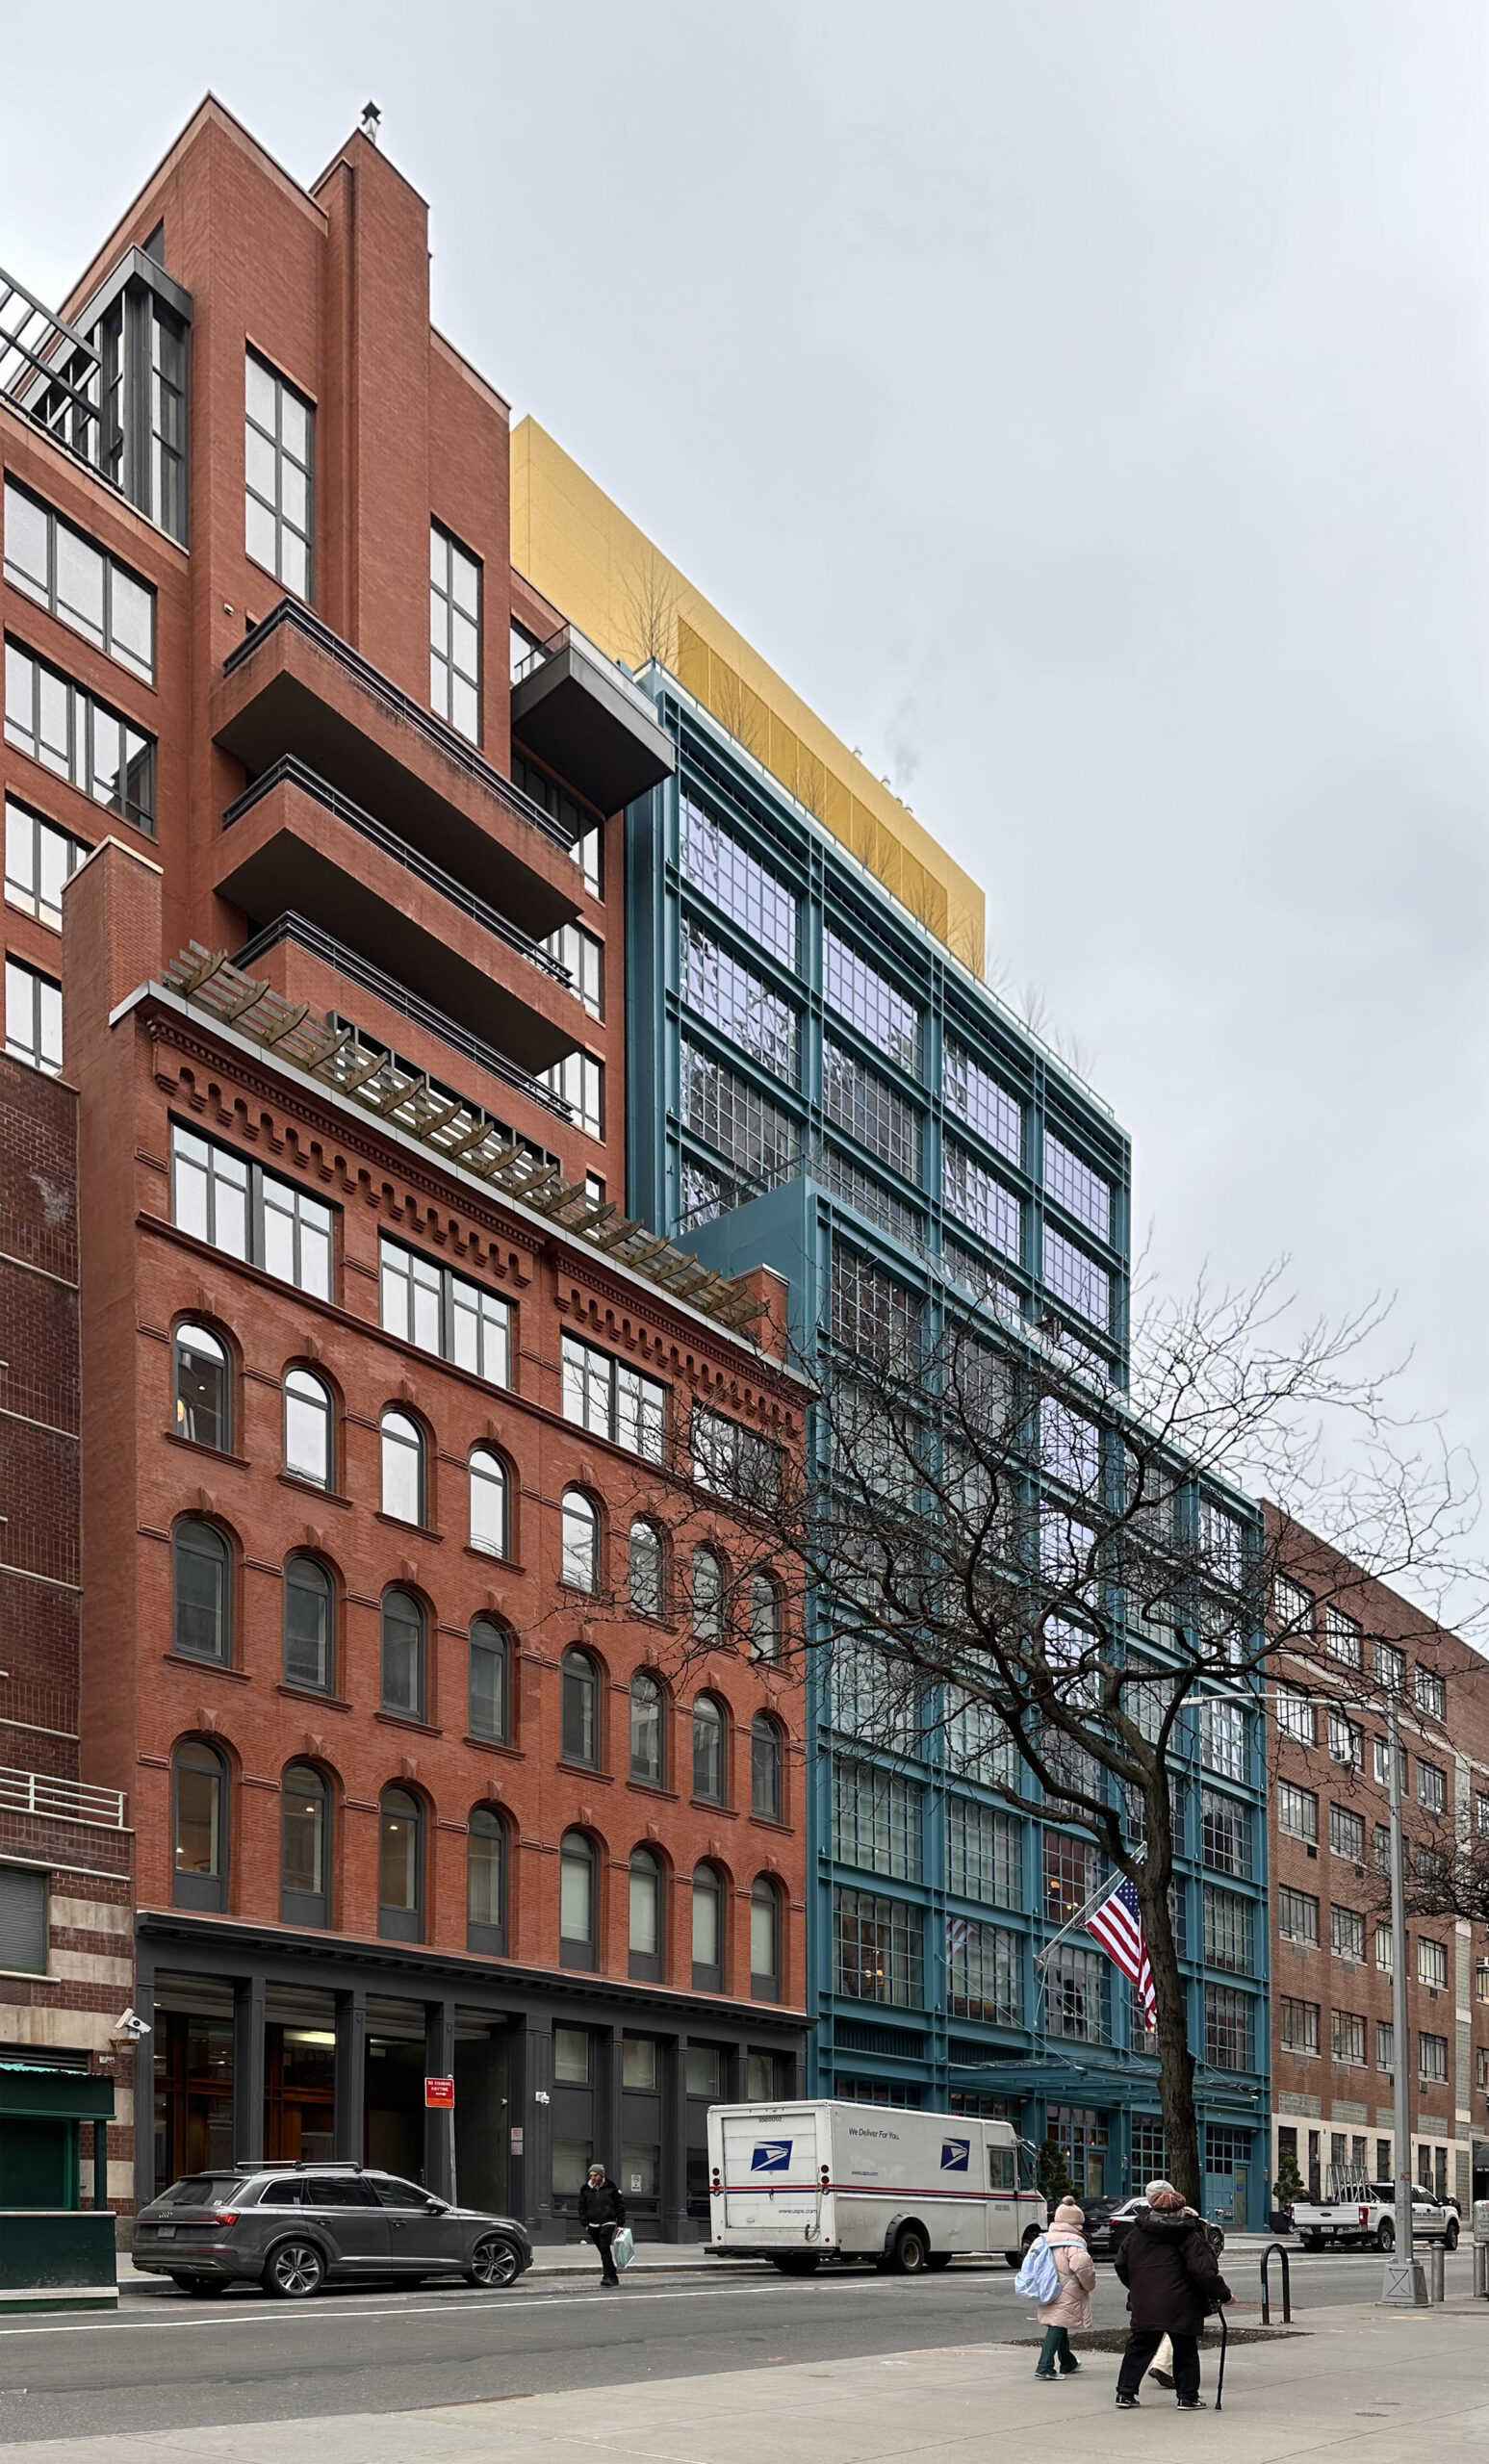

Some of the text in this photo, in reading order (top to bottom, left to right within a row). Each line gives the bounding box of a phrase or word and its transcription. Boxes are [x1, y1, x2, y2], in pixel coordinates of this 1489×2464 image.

[849, 2127, 858, 2136] We
[859, 2128, 878, 2137] Deliver
[879, 2130, 887, 2139] For
